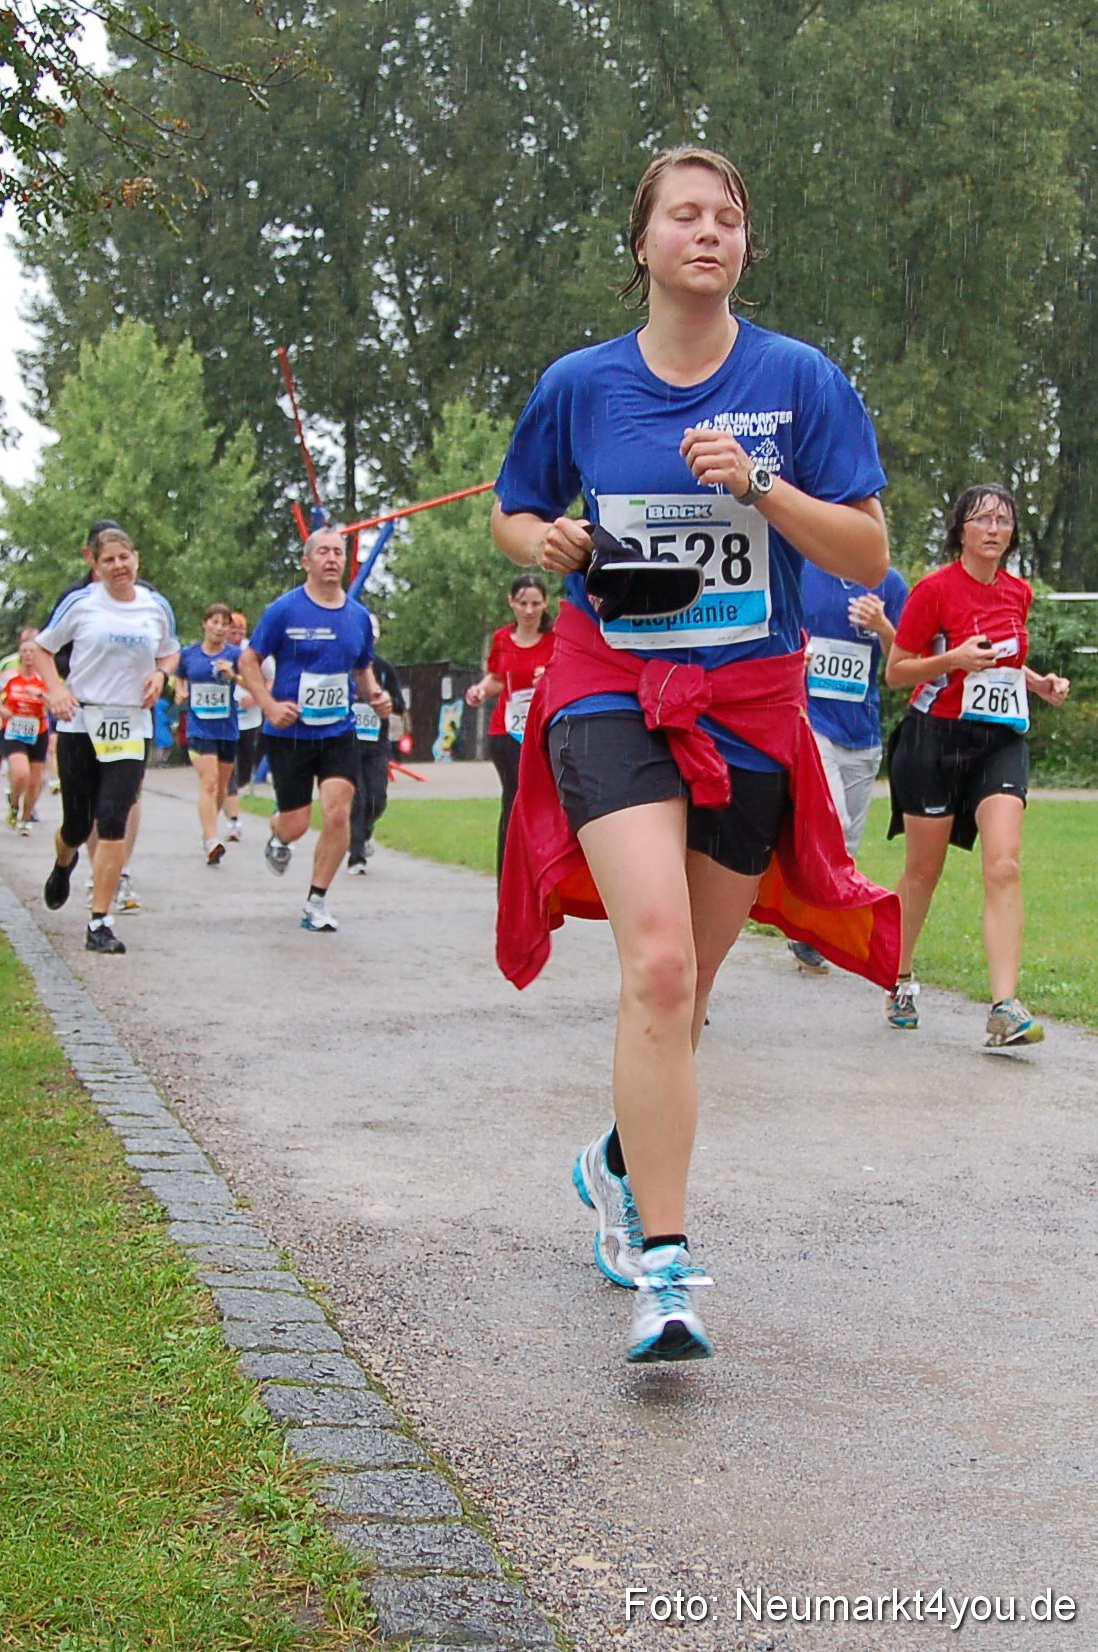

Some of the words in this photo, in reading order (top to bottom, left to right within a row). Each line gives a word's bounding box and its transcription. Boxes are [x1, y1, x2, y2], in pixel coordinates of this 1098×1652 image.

[714, 411, 792, 425] NEUMARKTER
[646, 505, 712, 519] BOCK
[814, 654, 864, 680] 3092
[972, 684, 1020, 714] 2661
[96, 721, 130, 741] 405
